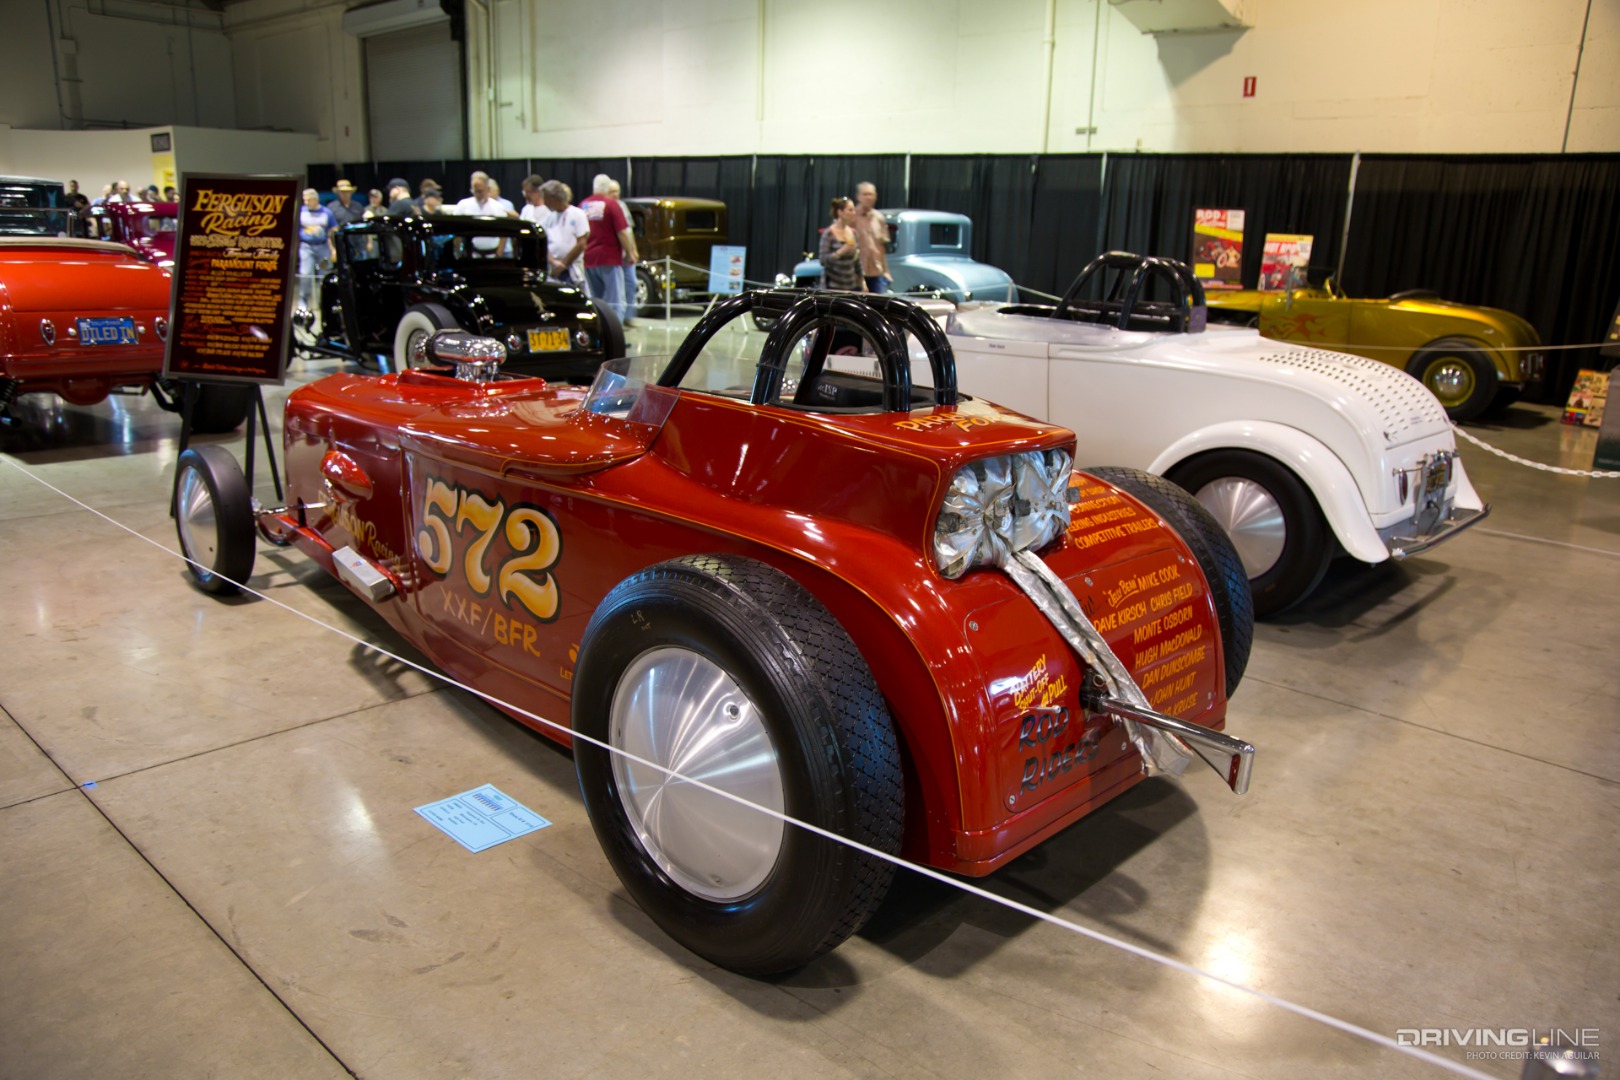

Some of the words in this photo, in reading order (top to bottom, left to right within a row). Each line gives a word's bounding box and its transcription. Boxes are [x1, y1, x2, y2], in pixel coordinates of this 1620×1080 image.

[192, 189, 289, 215] FERGUSON
[200, 212, 277, 236] Racing
[1091, 506, 1136, 525] INDUSTRIES
[418, 475, 562, 622] 572
[1075, 526, 1127, 549] COMPETITIVE
[1122, 518, 1160, 535] TRAILERS
[1138, 572, 1160, 591] MIKE
[1158, 564, 1181, 584] COOK
[440, 585, 541, 657] XXF/BFR
[1093, 613, 1118, 634] DAVE
[1117, 601, 1148, 625] KIRSCH
[1150, 593, 1173, 612] CHRIS
[1173, 583, 1193, 600] FIELD
[1134, 619, 1163, 645] MONTE
[1163, 605, 1193, 629] OSBORN
[1135, 647, 1158, 669] HUGH
[1142, 668, 1160, 690] DAN
[1160, 645, 1206, 681] DUNSCOMBE
[1047, 675, 1068, 704] PULL
[1150, 686, 1175, 707] JOHN
[1174, 671, 1197, 696] HUNT
[1171, 692, 1198, 716] KRUSE
[1018, 706, 1070, 753] ROD
[1020, 729, 1101, 796] RIDERS
